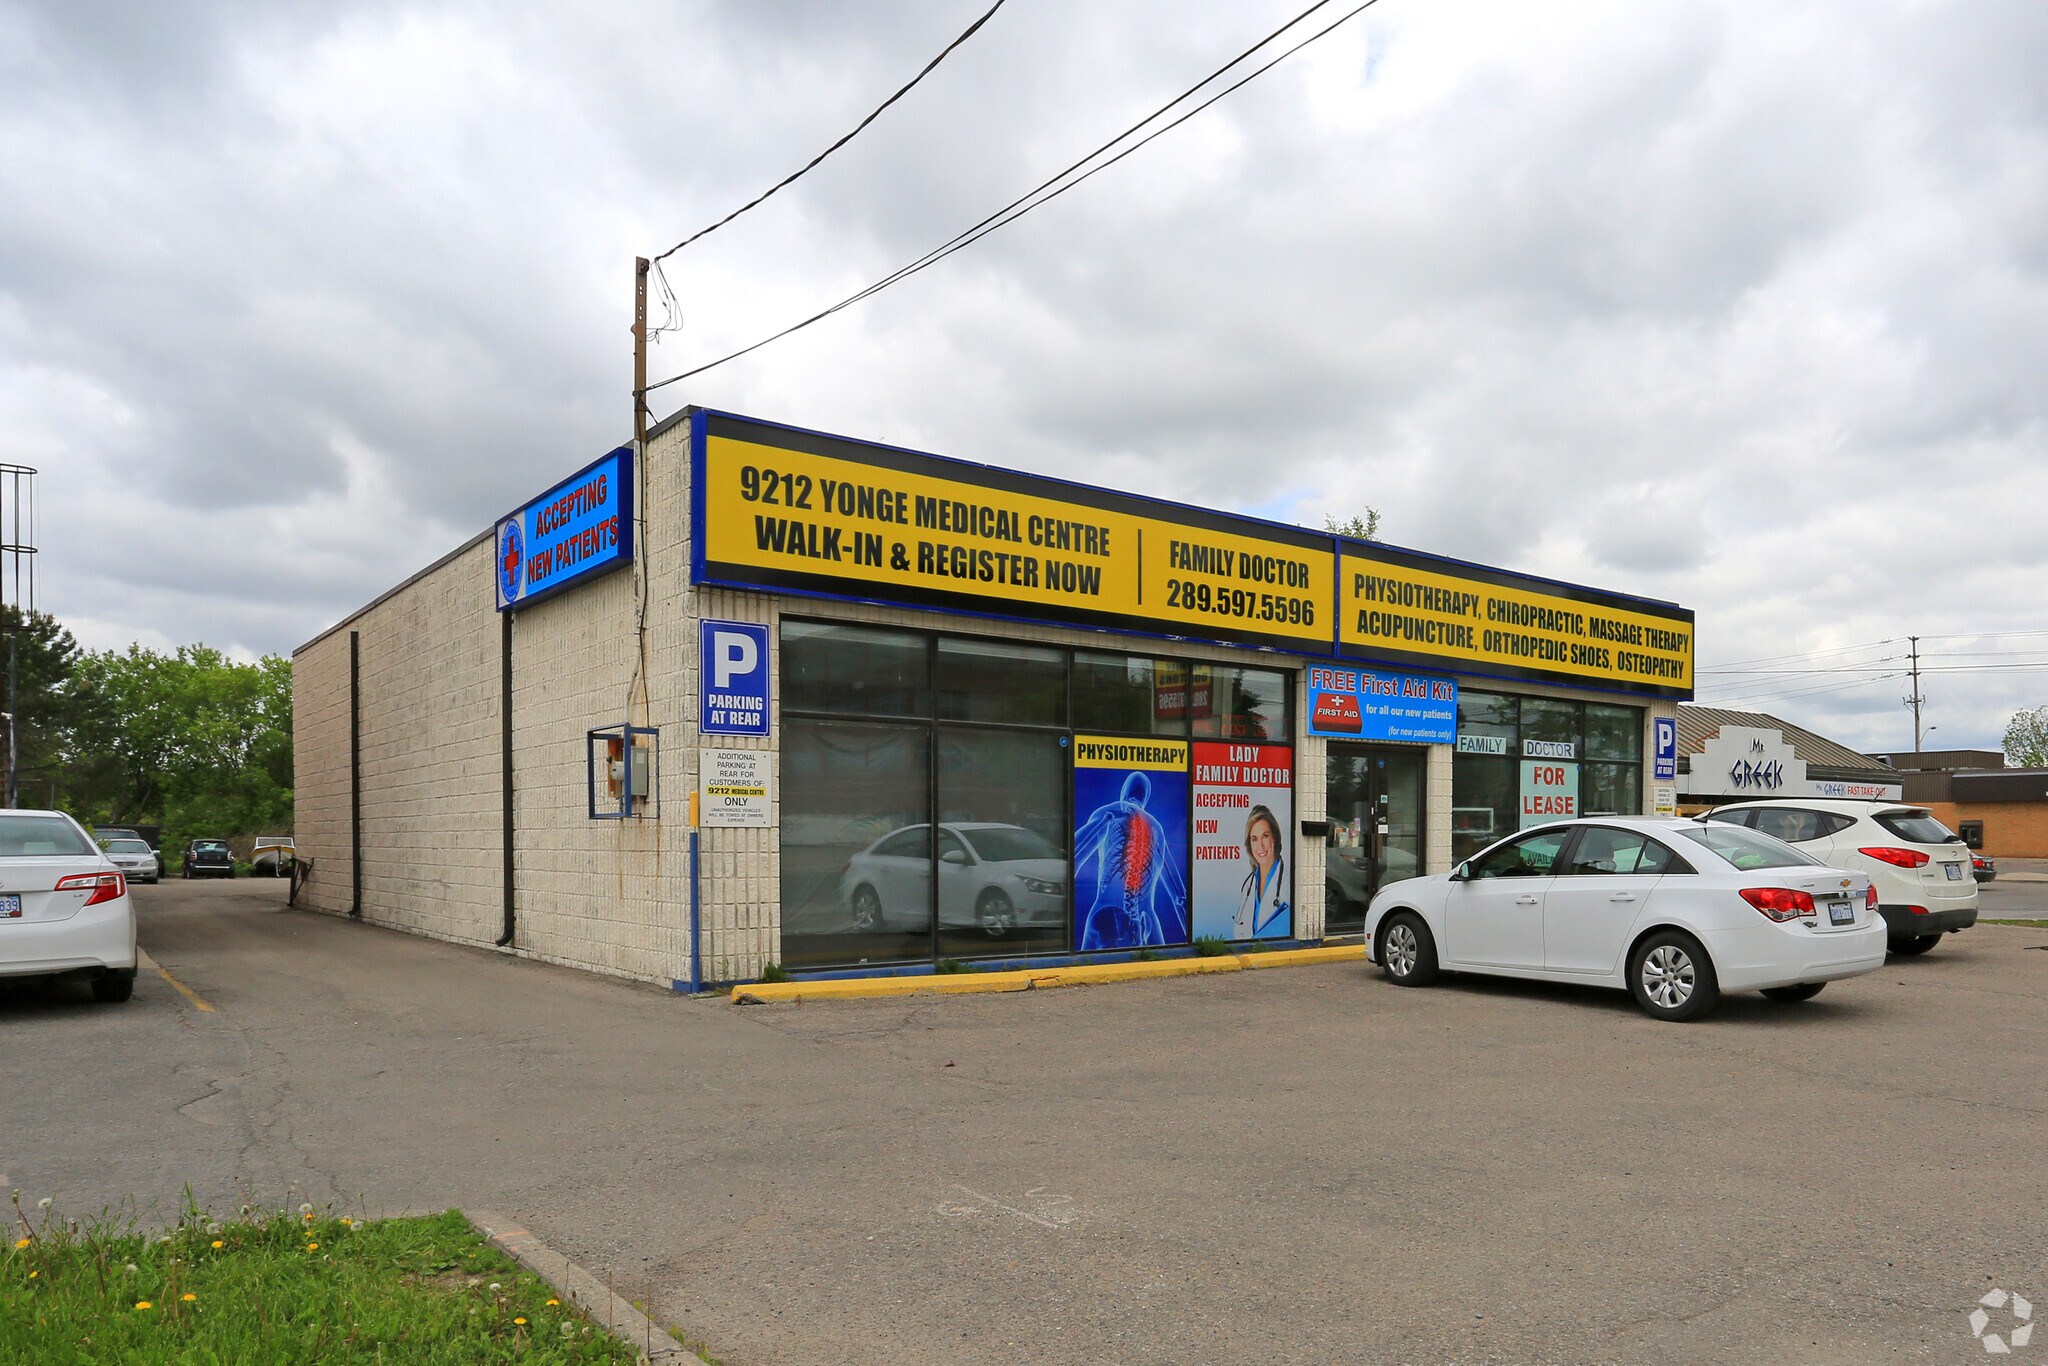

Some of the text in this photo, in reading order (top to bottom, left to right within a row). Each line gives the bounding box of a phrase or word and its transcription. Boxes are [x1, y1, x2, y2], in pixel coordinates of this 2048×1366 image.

[535, 474, 607, 540] ACCEPTING
[741, 465, 1110, 557] 9212 YONGE MEDICAL CENTRE
[527, 515, 619, 585] NEW PATIENTS
[755, 514, 1101, 596] WALK-IN & REGISTER NOW
[1170, 540, 1309, 589] FAMILY DOCTOR
[1167, 579, 1314, 626] 289.597.5596
[1354, 573, 1689, 654] PHYSIOTHERAPY, CHIROPRACTIC, MASSAGE THERAPY
[1357, 609, 1684, 679] ACUPUNCTURE, ORTHOPEDIC SHOES, OSTEOPATHY
[714, 631, 758, 688] P
[1311, 668, 1453, 701] FREE First Aid Kit
[708, 694, 763, 711] PARKING
[1366, 704, 1452, 720] for all our new patients
[711, 711, 760, 726] AT REAR
[1317, 708, 1358, 718] FIRST AID
[1388, 726, 1400, 737] (for
[1413, 729, 1436, 738] patients
[1438, 730, 1452, 740] only)
[1658, 723, 1673, 754] P
[717, 752, 756, 761] ADDITIONAL
[1077, 743, 1185, 764] PHYSIOTHERAPY
[1229, 745, 1259, 763] LADY
[1460, 737, 1572, 757] FAMILY DOCTOR
[717, 761, 746, 769] PARKING
[1196, 764, 1290, 785] FAMILY DOCTOR
[1729, 759, 1783, 789] GREEK
[709, 778, 751, 786] CUSTOMERS
[1533, 766, 1565, 786] FOR
[1824, 783, 1846, 796] GREEK
[1848, 785, 1859, 795] FAST
[724, 796, 748, 806] ONLY
[1196, 793, 1250, 808] ACCEPTING
[1523, 796, 1574, 815] LEASE
[1196, 819, 1218, 834] NEW
[1196, 845, 1240, 860] PATIENTS
